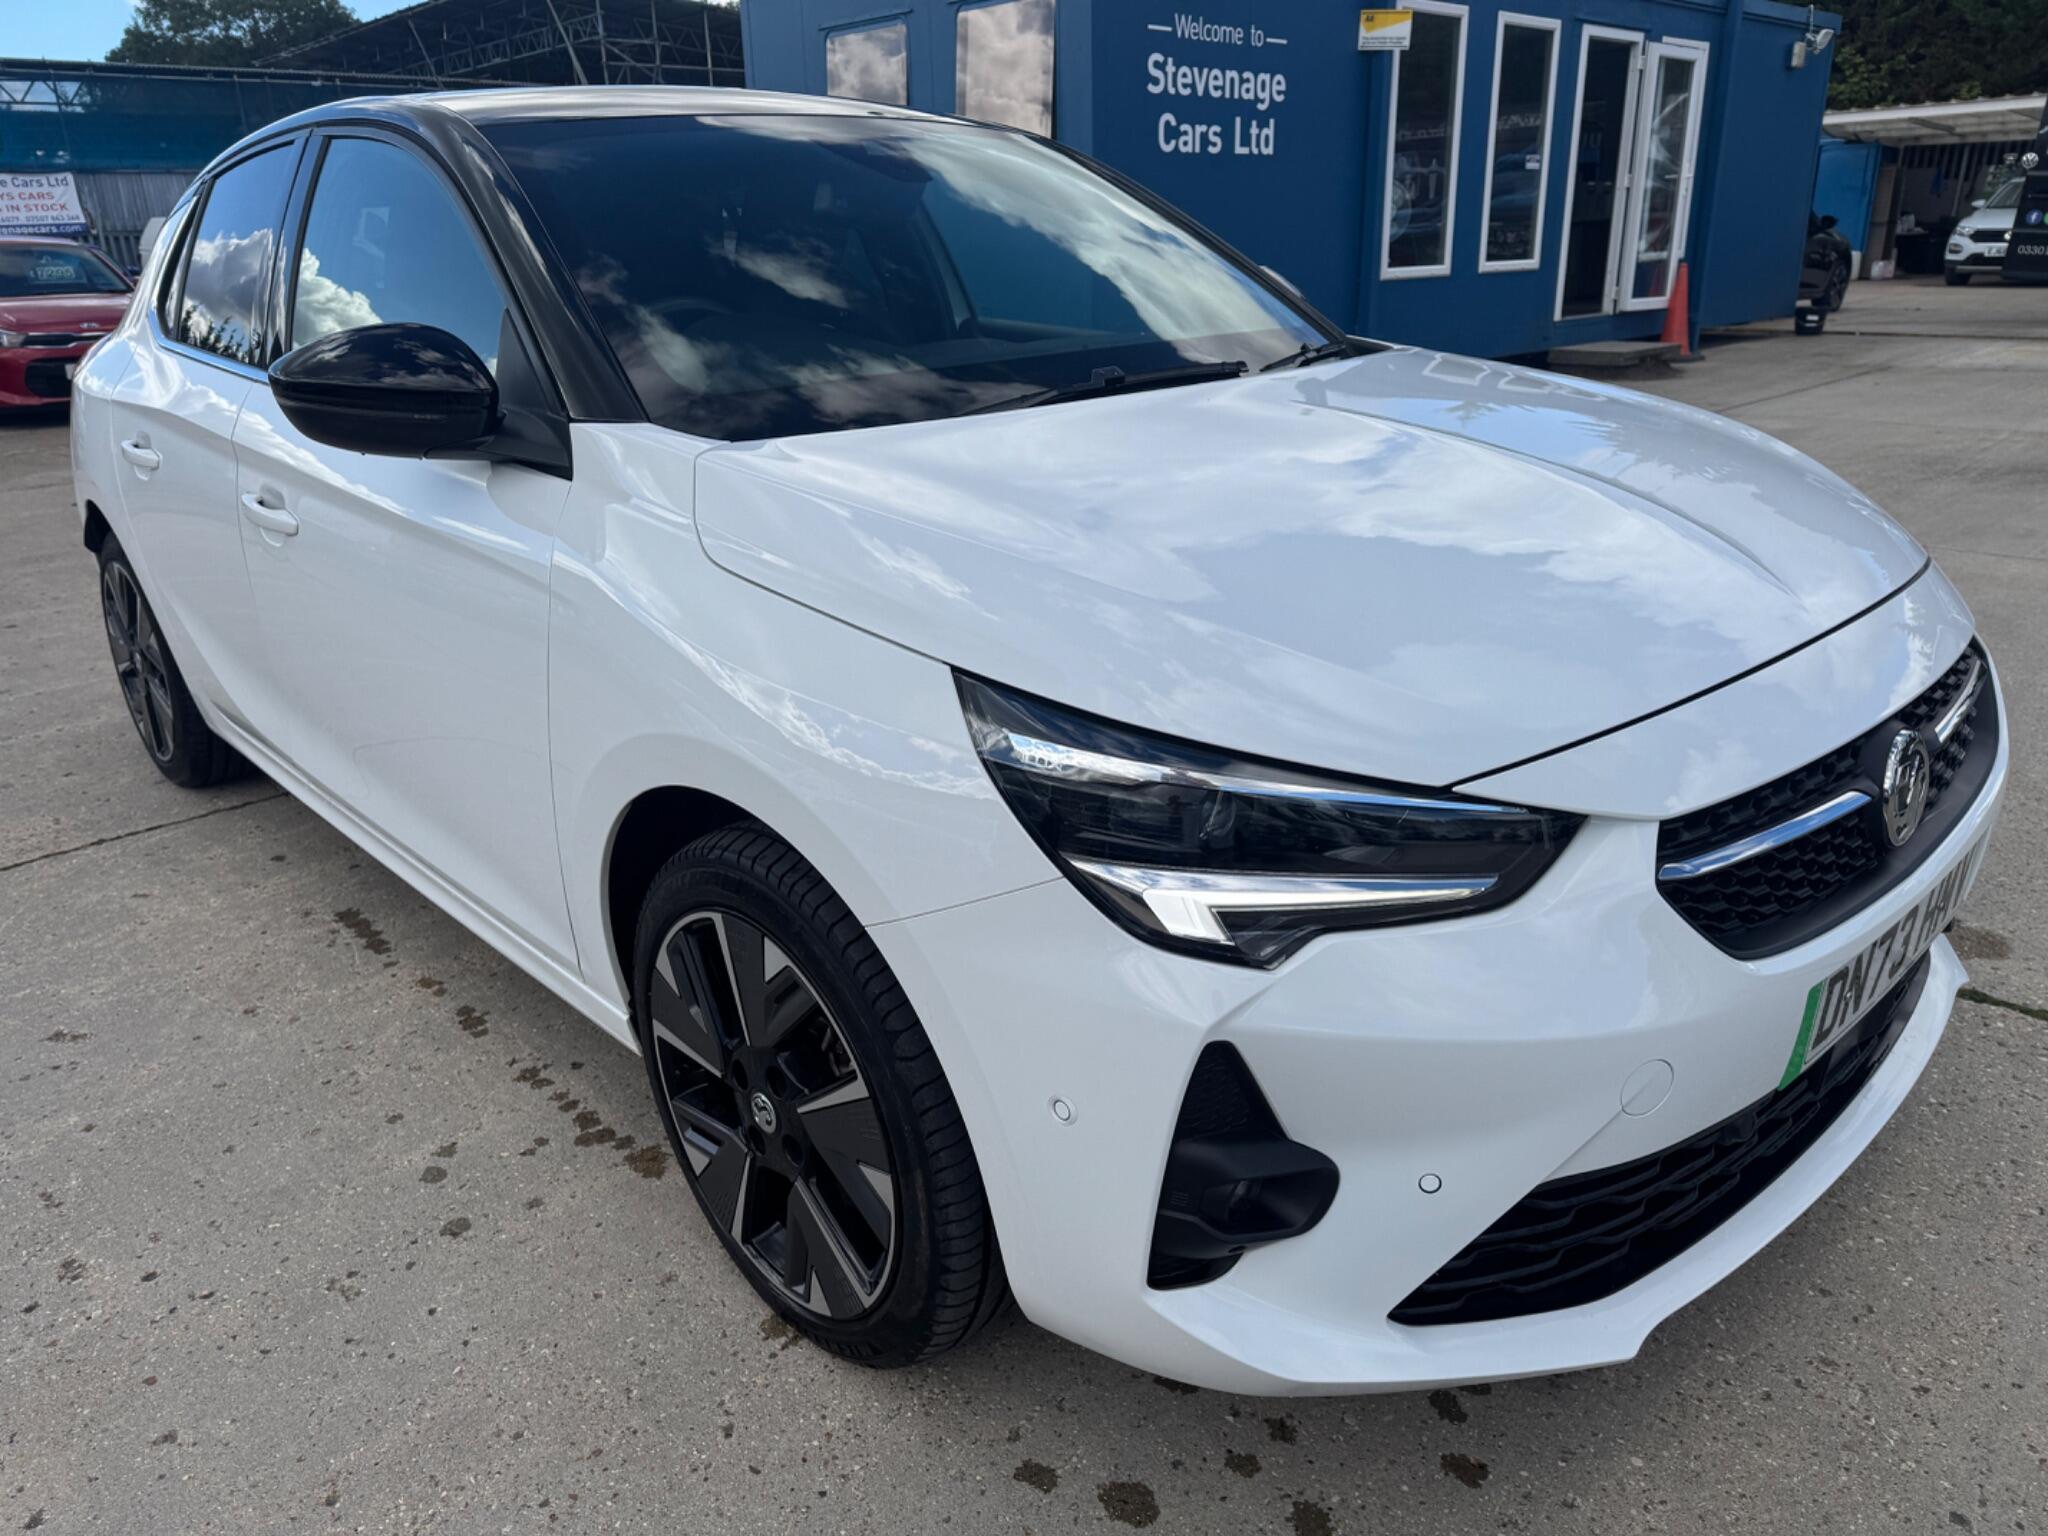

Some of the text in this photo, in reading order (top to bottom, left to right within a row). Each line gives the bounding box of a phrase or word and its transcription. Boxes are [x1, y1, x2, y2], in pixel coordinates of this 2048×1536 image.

[1174, 13, 1265, 47] Welcome to
[1146, 52, 1287, 111] Stevenage
[1158, 112, 1275, 155] Cars Ltd
[11, 176, 44, 188] Cars
[45, 175, 69, 187] Ltd
[18, 191, 55, 200] CARS
[6, 204, 20, 212] IN
[23, 202, 69, 212] STOCK
[1811, 904, 1920, 1051] DN73
